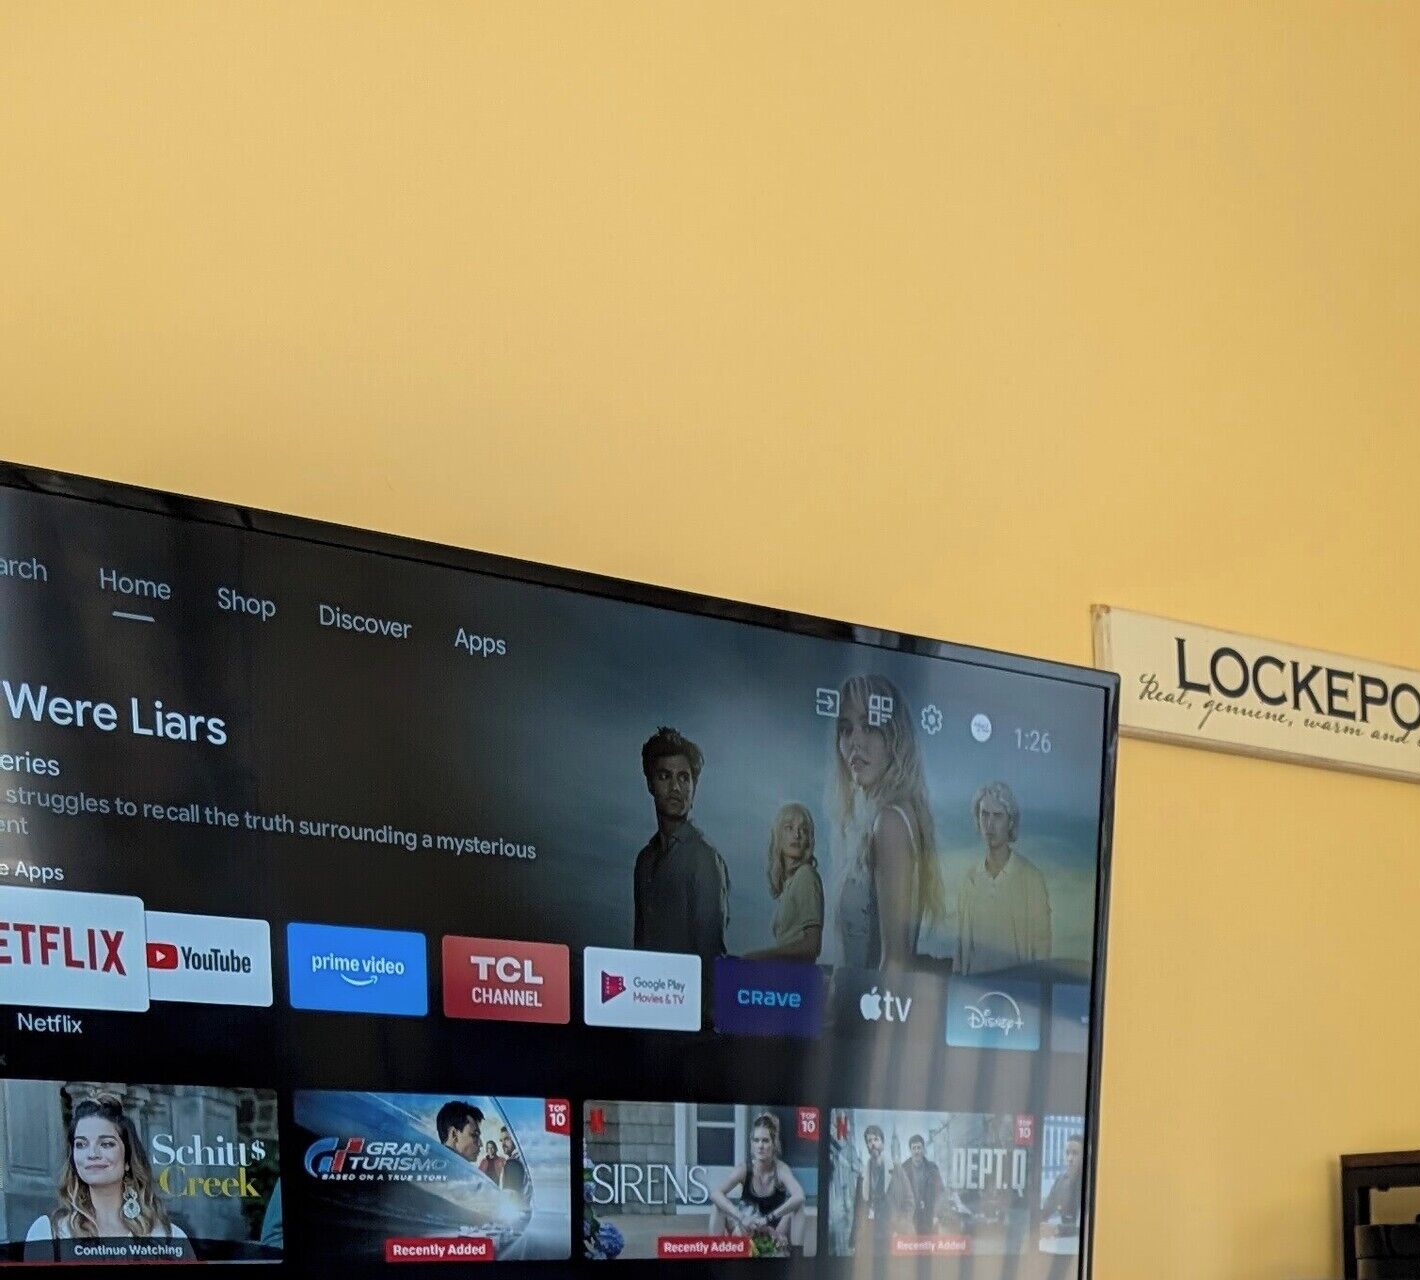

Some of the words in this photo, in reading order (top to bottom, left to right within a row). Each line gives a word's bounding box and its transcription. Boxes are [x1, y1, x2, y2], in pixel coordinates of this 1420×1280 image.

[99, 567, 171, 600] Home
[217, 586, 276, 622] Shop
[318, 604, 413, 640] Discover
[454, 627, 507, 657] Apps
[2, 680, 118, 732] Were
[131, 696, 228, 746] Liars
[1015, 728, 1052, 754] 1:26
[1303, 718, 1364, 737] warm
[1370, 729, 1410, 745] and
[6, 786, 111, 816] struggles
[115, 797, 138, 817] to
[143, 802, 200, 824] recall
[204, 806, 240, 828] the
[245, 810, 295, 834] truth
[299, 820, 417, 851] surrounding
[422, 833, 432, 849] a
[437, 834, 537, 860] mysterious
[14, 861, 65, 884] Apps
[180, 946, 252, 974] YouTube
[311, 952, 360, 973] prime
[361, 955, 405, 976] video
[470, 955, 544, 985] TCL
[633, 976, 667, 992] Google
[667, 978, 686, 993] Play
[471, 987, 543, 1008] CHANNEL
[633, 992, 664, 1005] Movies
[672, 994, 685, 1006] TV
[883, 990, 913, 1022] tv
[17, 1012, 83, 1034] Netflix
[548, 1103, 567, 1114] TOP
[549, 1113, 566, 1127] 10
[801, 1119, 816, 1134] 10
[366, 1141, 430, 1157] GRAN
[349, 1156, 448, 1172] TURISMO
[1011, 1147, 1028, 1198] Q
[159, 1164, 261, 1198] Creek
[321, 1173, 356, 1181] BASED
[358, 1173, 375, 1181] ON
[375, 1173, 385, 1181] A
[387, 1173, 414, 1181] TRUE
[591, 1163, 709, 1205] SIRENS
[74, 1244, 127, 1257] Continue
[128, 1243, 184, 1258] Watching
[392, 1242, 446, 1258] Recently
[447, 1242, 487, 1256] Added
[663, 1241, 709, 1255] Recently
[710, 1241, 744, 1253] Added
